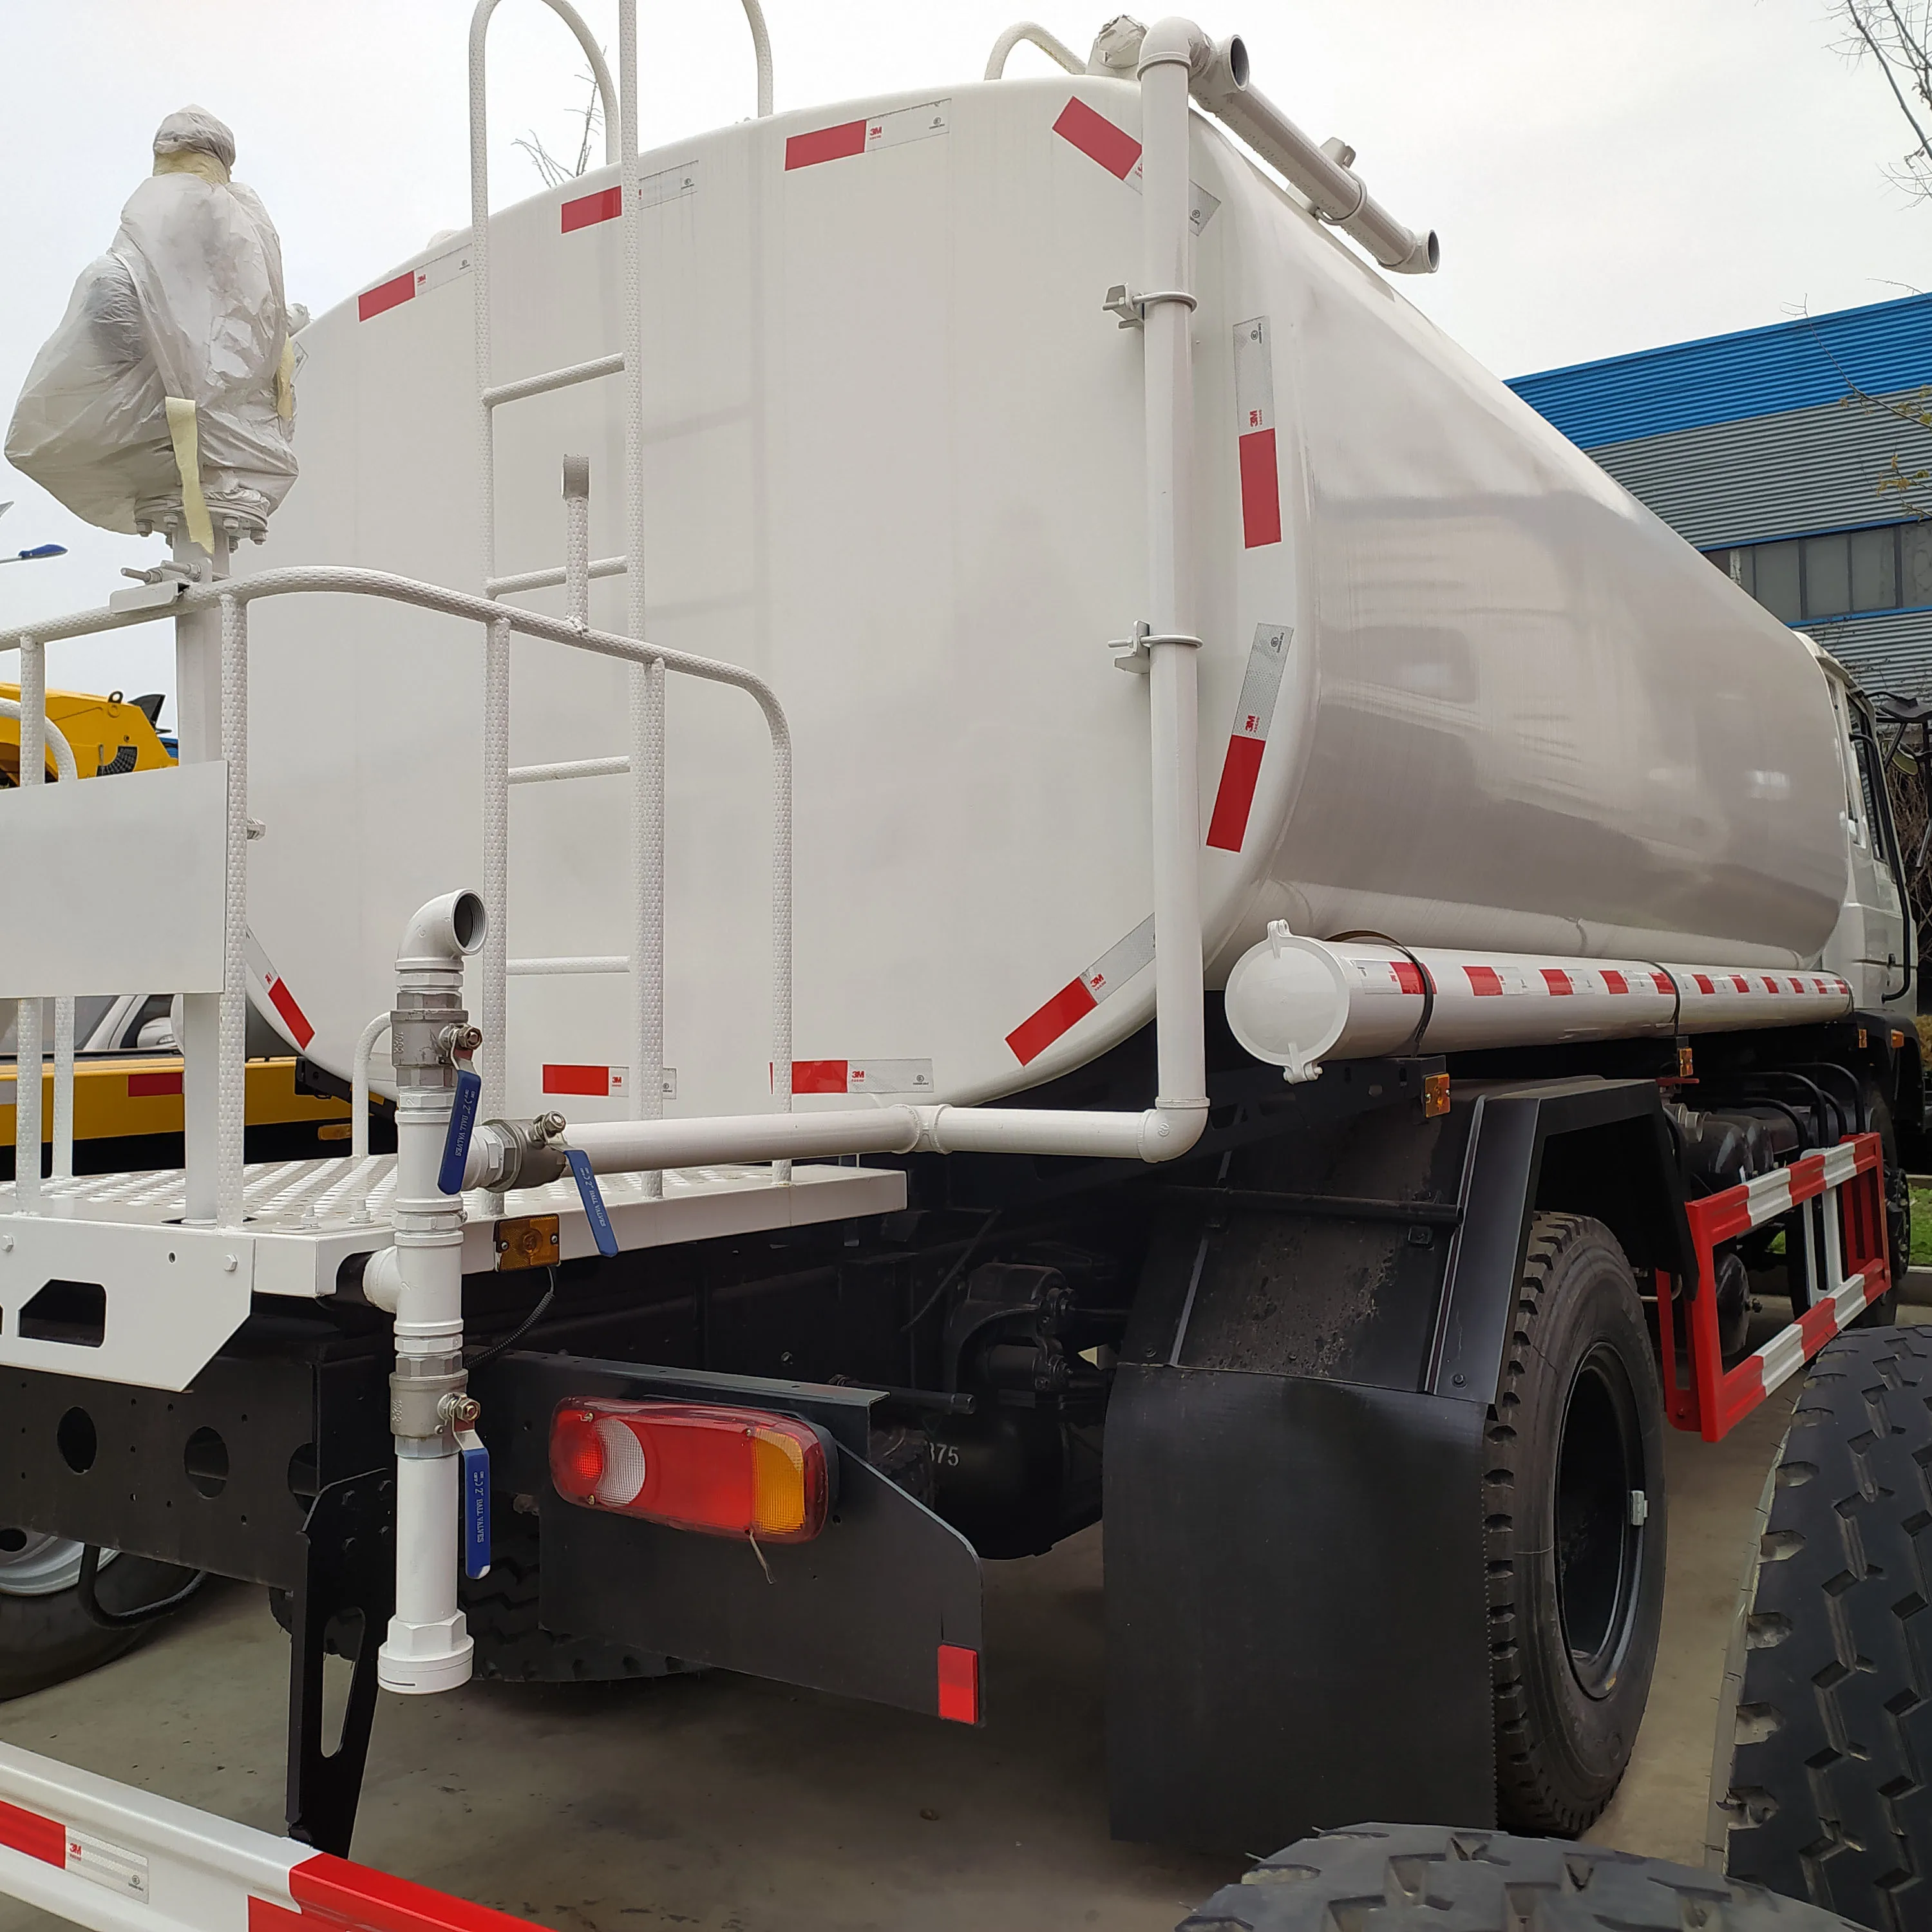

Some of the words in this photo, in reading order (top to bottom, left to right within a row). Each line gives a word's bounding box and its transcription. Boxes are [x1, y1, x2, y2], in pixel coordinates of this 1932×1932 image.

[869, 126, 882, 136] 3M
[1249, 410, 1258, 427] 3M
[1245, 715, 1256, 732] 3M
[1090, 973, 1104, 987] 3M
[851, 1070, 865, 1079] 3M
[460, 1115, 468, 1131] BALL
[455, 1131, 465, 1156] VALVES
[589, 1190, 598, 1204] BALL
[595, 1204, 606, 1227] VALVES
[476, 1517, 484, 1542] VALVES
[70, 1842, 82, 1855] 3M
